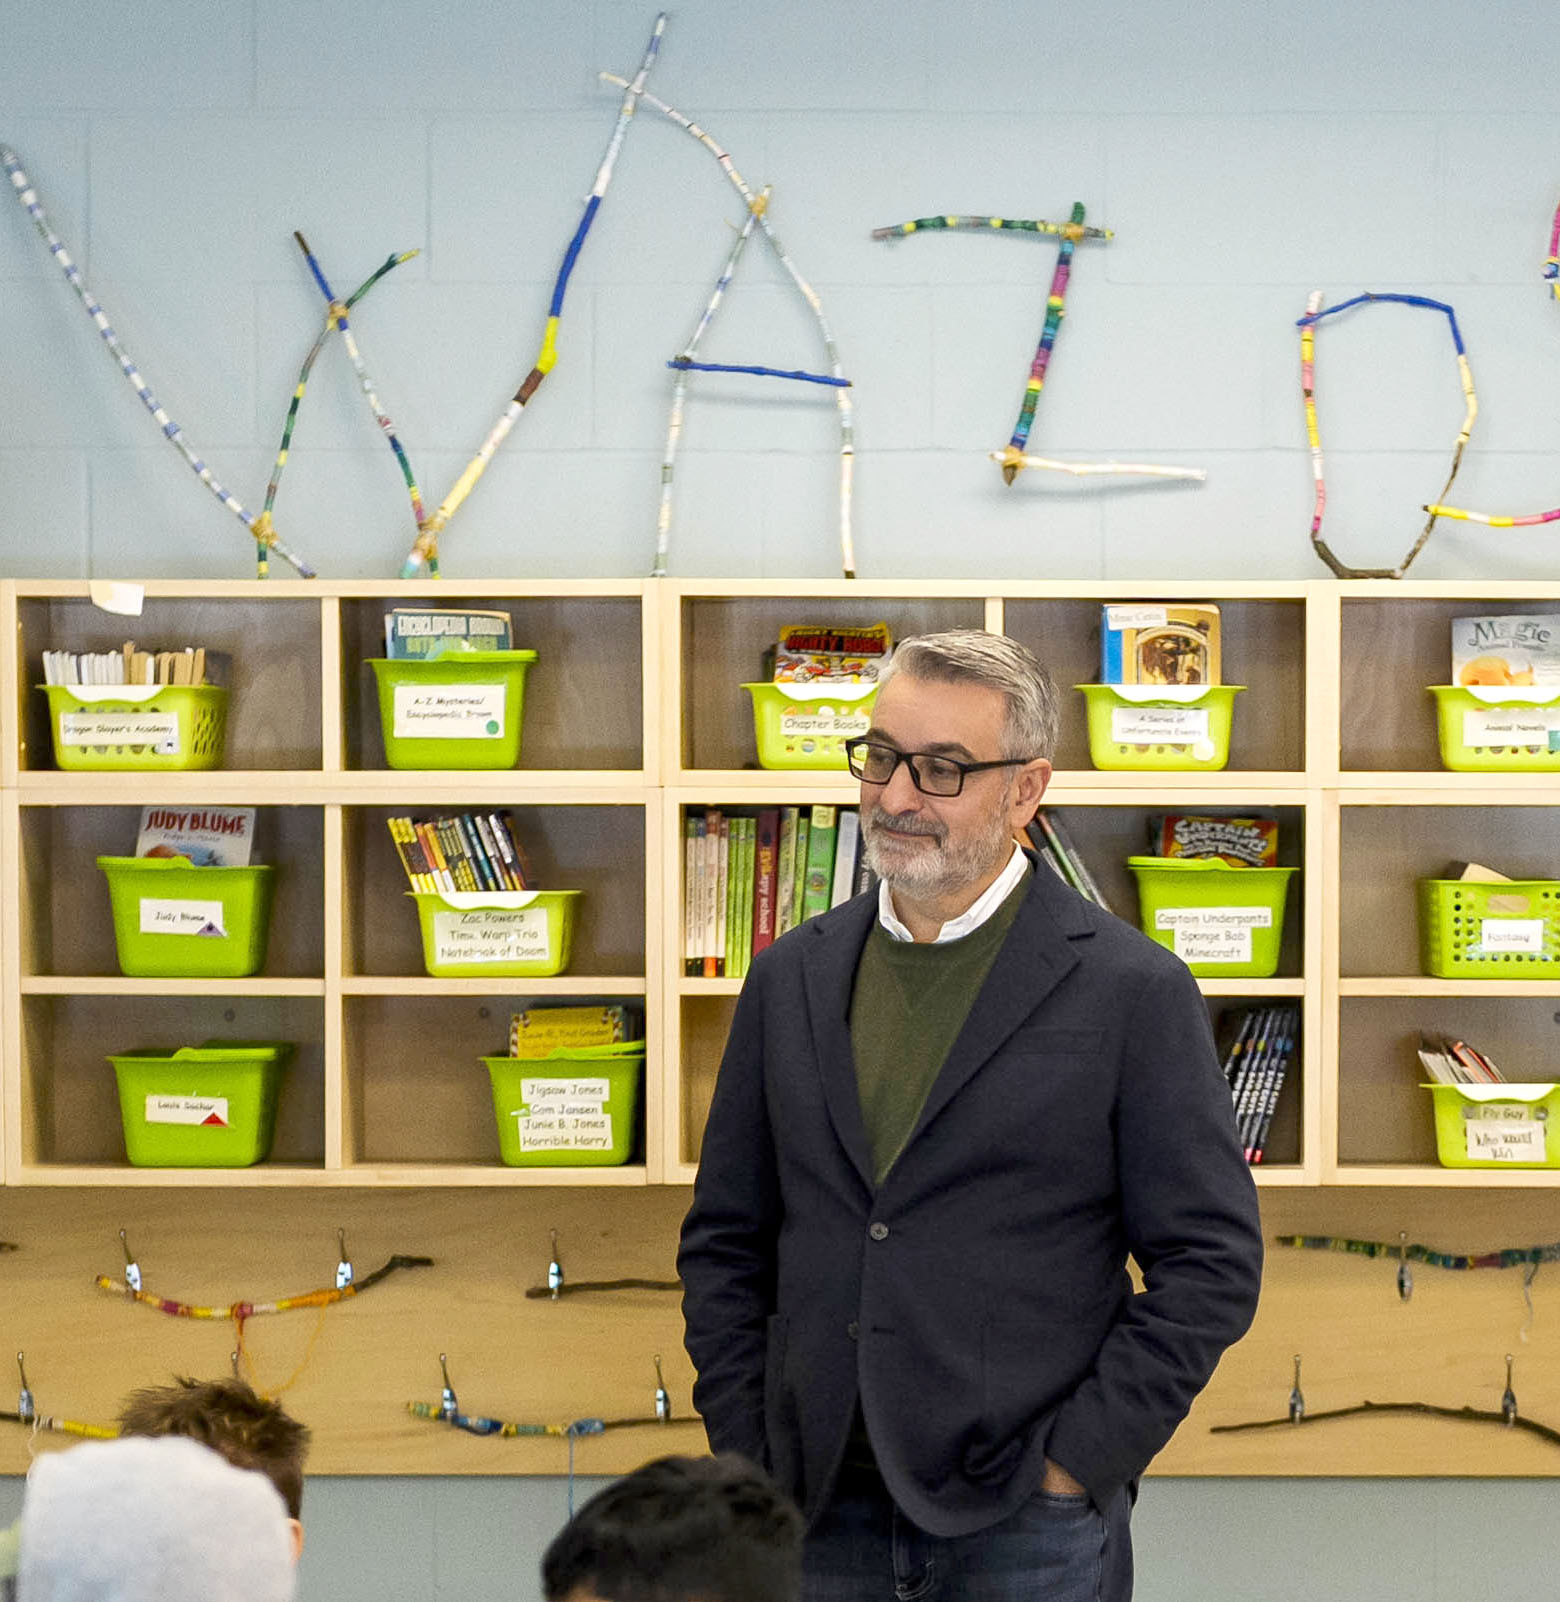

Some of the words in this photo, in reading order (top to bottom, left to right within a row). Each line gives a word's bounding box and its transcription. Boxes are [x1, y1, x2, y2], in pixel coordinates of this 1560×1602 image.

[784, 718, 831, 730] Chapter
[833, 718, 868, 730] Books
[145, 809, 188, 832] JUDY
[189, 809, 247, 836] BLUME
[460, 912, 482, 924] Zac
[485, 912, 525, 924] Powers
[1157, 913, 1200, 926] Captain
[1202, 913, 1269, 926] Underpants
[480, 929, 511, 943] Warp
[515, 929, 539, 940] Trio
[1180, 930, 1222, 944] Sponge
[1225, 930, 1246, 942] Bob
[515, 945, 547, 957] Doom
[1185, 947, 1242, 960] Minecraft
[529, 1084, 567, 1098] Jigsaw
[570, 1084, 604, 1095] Jones
[557, 1104, 598, 1115] Jansen
[523, 1119, 554, 1131] Junie
[571, 1119, 606, 1131] Jones
[521, 1135, 571, 1147] Horrible
[573, 1135, 609, 1148] Harry
